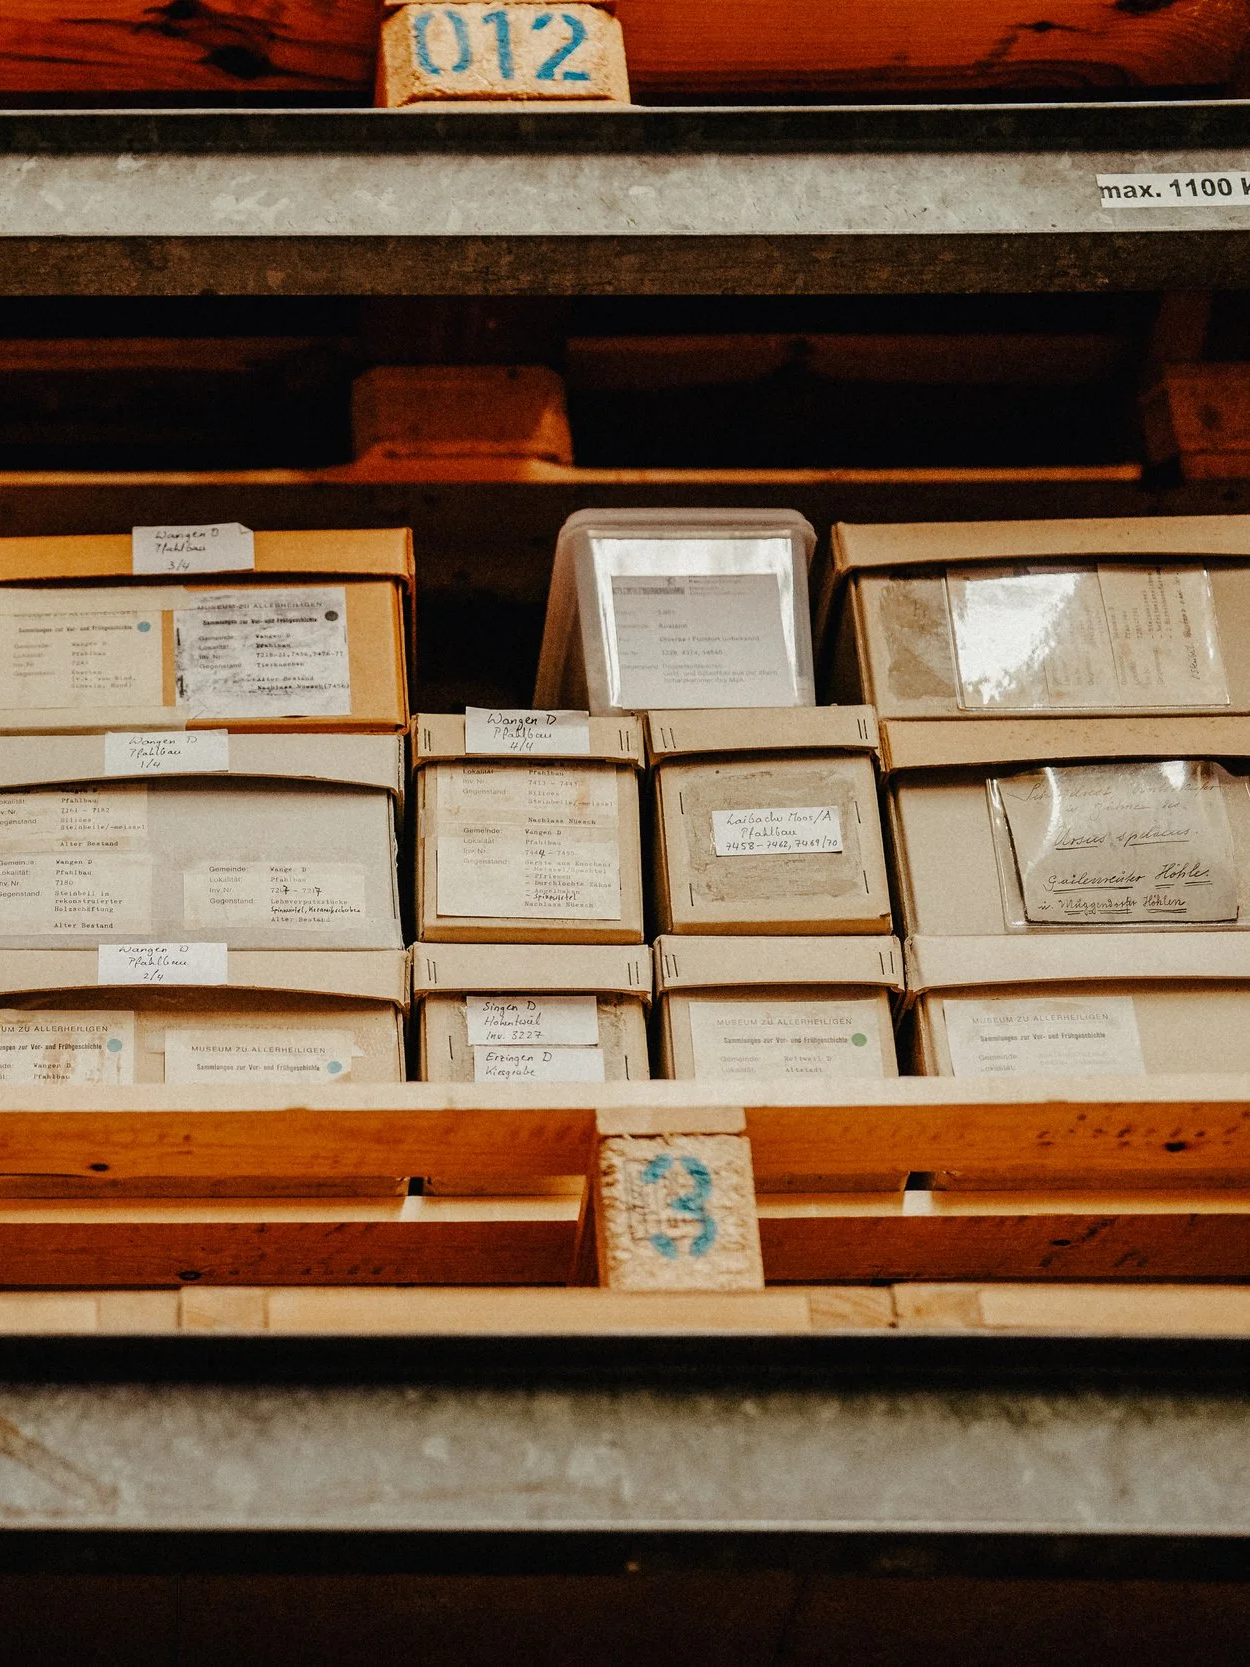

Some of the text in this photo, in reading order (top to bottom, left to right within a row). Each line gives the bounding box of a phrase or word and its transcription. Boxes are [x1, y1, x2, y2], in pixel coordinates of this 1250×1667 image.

[413, 10, 590, 81] 012
[1100, 184, 1161, 199] max.
[1170, 178, 1232, 197] 1100
[168, 560, 190, 571] 3/4
[487, 713, 557, 731] Wangen D
[493, 726, 552, 740] Pfahlbau
[129, 736, 197, 747] Wangen D
[510, 741, 534, 751] 4/4
[130, 747, 182, 759] Pfahlbau
[140, 759, 161, 769] 1/4
[788, 810, 831, 824] Moos/A
[741, 827, 797, 838] Pfahlbau
[119, 945, 189, 956] Wangen D
[128, 956, 188, 969] Pfahlbau
[143, 969, 164, 981] 2/4
[483, 1001, 536, 1016] Singen D
[484, 1012, 542, 1026] Hohentwiel
[972, 1016, 1013, 1024] MUSEUM
[1033, 1013, 1109, 1022] ALLERHEILIGEN
[34, 1025, 108, 1033] ALLERHEILIGEN
[486, 1031, 545, 1040] Inv. 3227
[804, 1036, 848, 1044] Frühgeschichte
[1061, 1032, 1106, 1041] Frühgeschichte
[58, 1043, 102, 1051] Frühgeschichte
[251, 1046, 326, 1054] ALLERHEILIGEN
[486, 1052, 552, 1066] Erzingen D
[196, 1063, 234, 1071] Sammlungen
[277, 1064, 320, 1072] Frühgeschichte
[485, 1066, 535, 1079] Kiesgrube
[640, 1152, 718, 1261] 3
